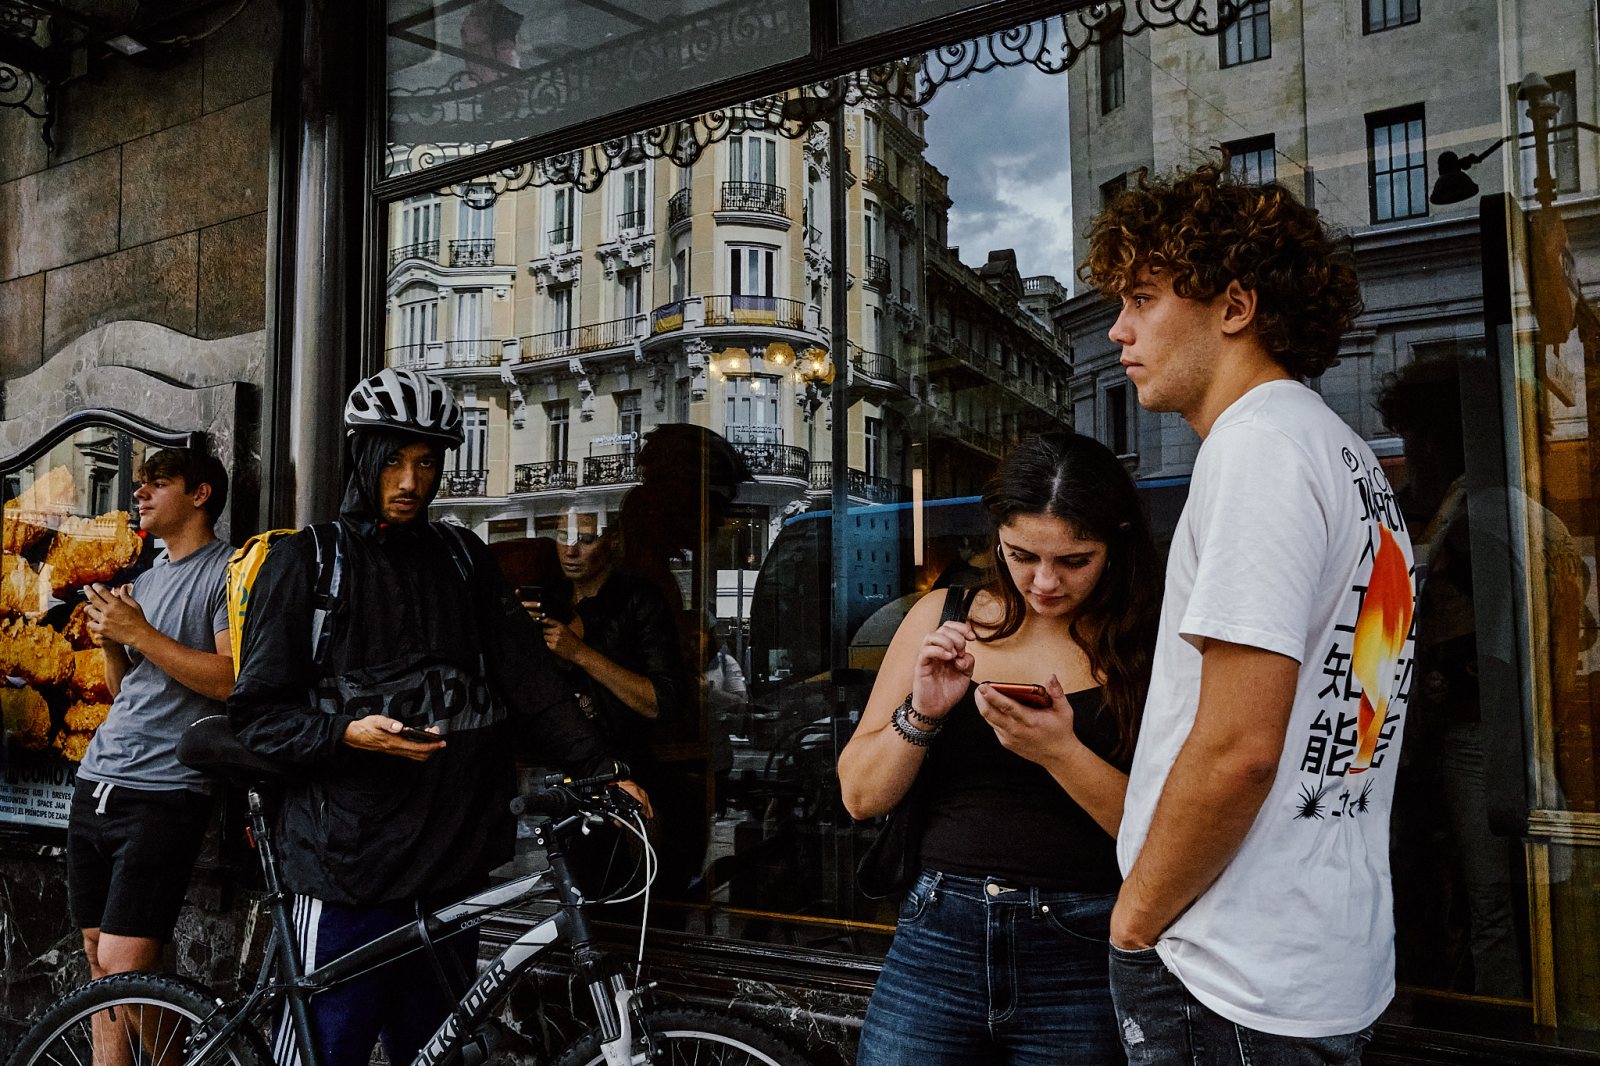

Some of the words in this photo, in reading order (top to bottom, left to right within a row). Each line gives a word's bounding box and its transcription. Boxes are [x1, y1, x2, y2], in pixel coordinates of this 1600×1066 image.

[52, 791, 71, 800] BREVES
[37, 799, 53, 808] SPACE
[55, 802, 66, 810] JAM
